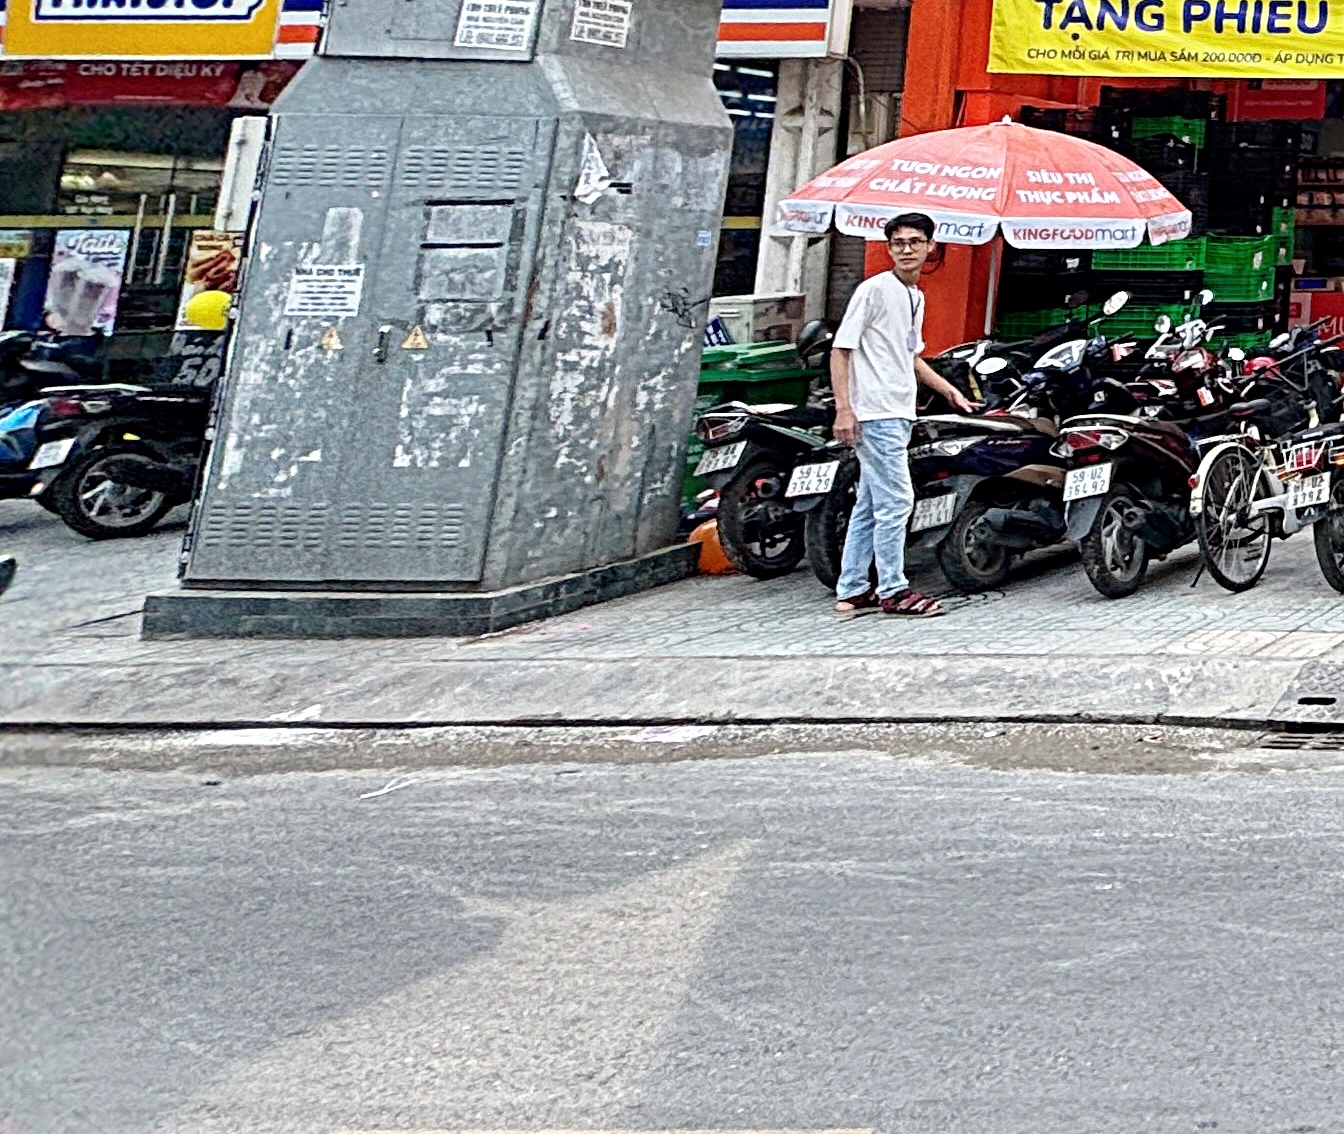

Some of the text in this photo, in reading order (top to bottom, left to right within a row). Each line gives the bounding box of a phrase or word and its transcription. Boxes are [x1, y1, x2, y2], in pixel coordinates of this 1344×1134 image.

[1027, 47, 1057, 60] CHO
[1061, 44, 1086, 61] MỖI
[1088, 48, 1110, 61] GIÁ
[1115, 50, 1134, 65] TRỊ
[1137, 51, 1167, 62] MUA
[1172, 46, 1199, 63] SẮM
[1274, 50, 1293, 64] ÁP
[1296, 53, 1334, 67] DỤNG
[79, 64, 116, 76] CHO
[942, 165, 1002, 180] NGON
[1026, 169, 1064, 185] SIÊU
[1064, 172, 1097, 187] THỊ
[869, 177, 926, 195] CHẤT
[925, 183, 997, 201] LƯỢNG
[1015, 188, 1064, 204] THỰC
